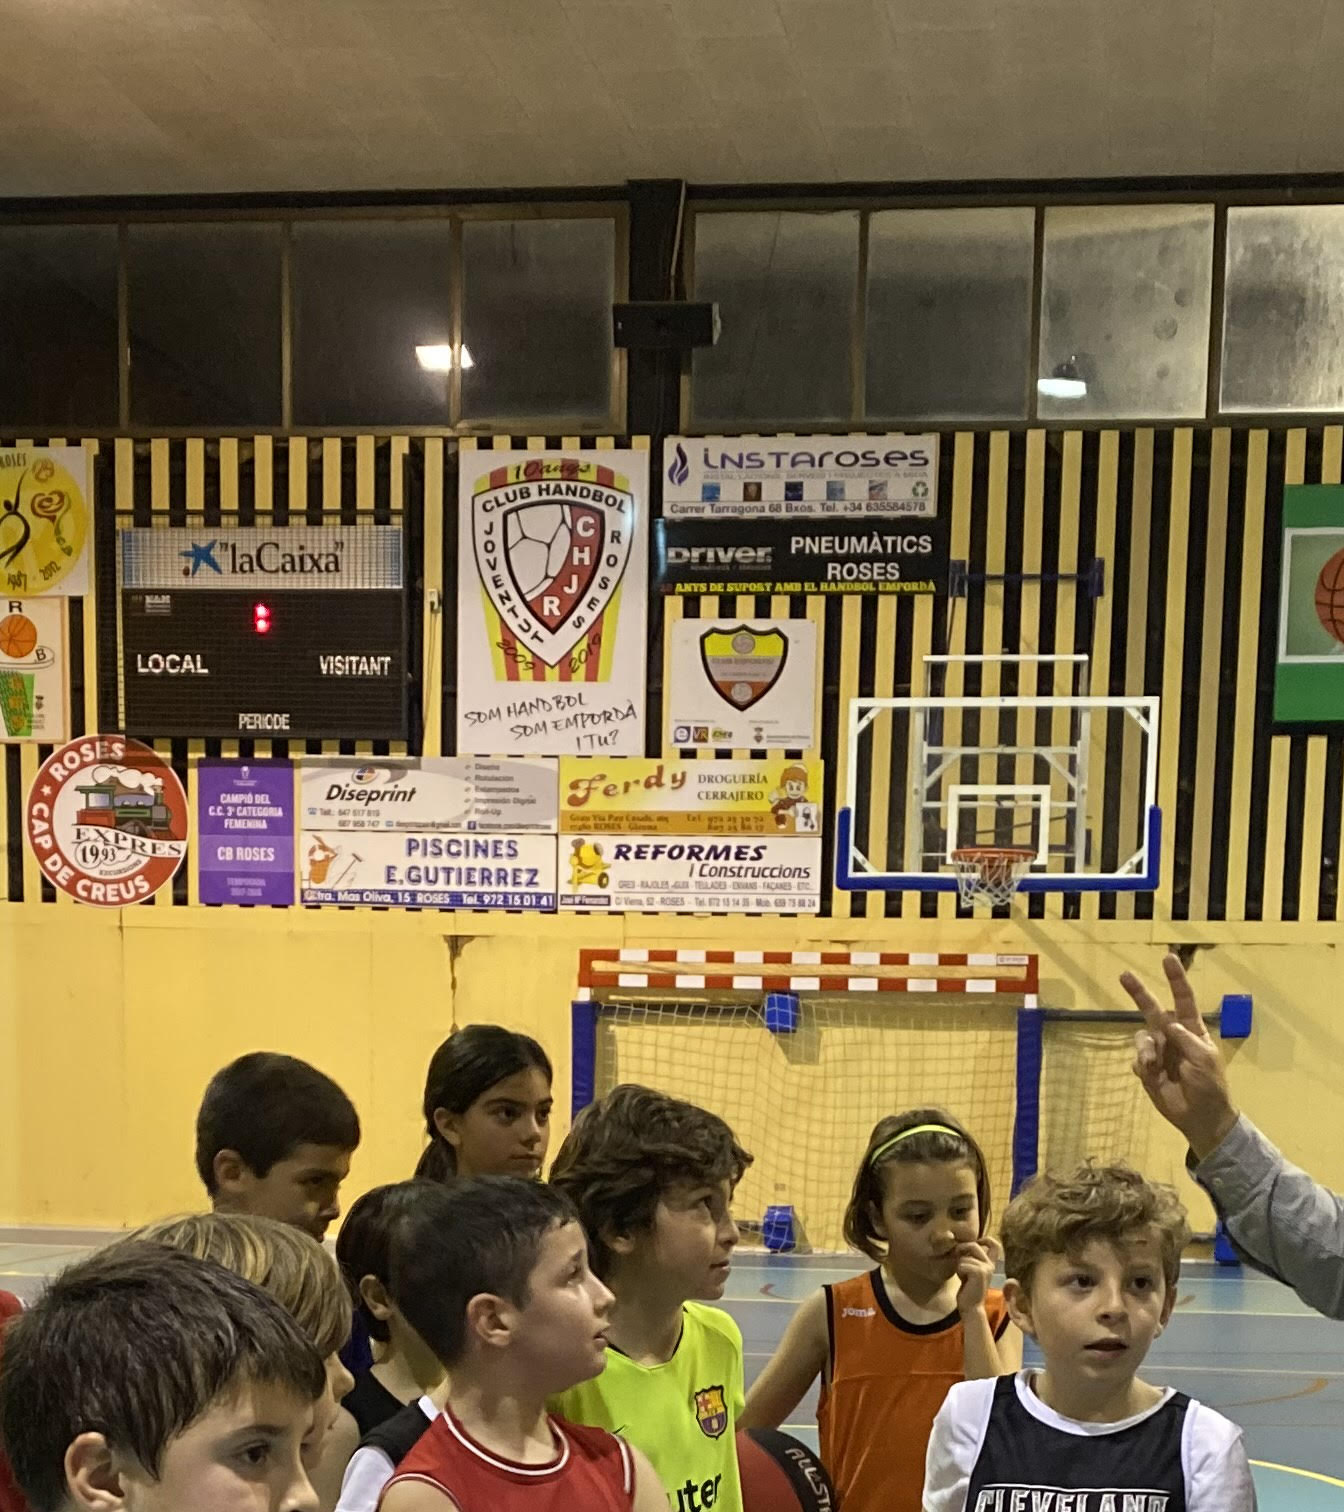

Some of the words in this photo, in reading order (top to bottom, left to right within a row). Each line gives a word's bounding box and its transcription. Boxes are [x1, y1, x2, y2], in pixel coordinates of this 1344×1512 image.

[482, 486, 531, 513] CLUB
[538, 484, 626, 513] HANDBOL
[670, 504, 705, 514] Carrer
[710, 503, 765, 515] Tarragona
[768, 503, 782, 513] 68
[820, 503, 838, 512] Tel.
[843, 502, 862, 512] +34
[790, 531, 932, 554] PNEUMÀTICS
[827, 562, 900, 580] ROSES
[675, 582, 707, 593] ANYS
[709, 582, 724, 592] DE
[774, 582, 802, 592] AMB
[804, 582, 817, 592] EL
[8, 601, 23, 613] R
[137, 654, 209, 674] LOCAL
[319, 655, 391, 675] VISITANT
[238, 713, 291, 730] PERIODE
[48, 741, 126, 782] ROSES
[566, 764, 687, 807] Ferdy
[698, 773, 768, 784] DROGUERÍA
[254, 794, 271, 805] DEL
[325, 783, 417, 806] Diseprint
[697, 790, 764, 802] CERRAJERO
[236, 806, 283, 817] CATEGORIA
[75, 827, 182, 856] EXPRES
[405, 837, 519, 859] PISCINES
[31, 802, 53, 850] CAP
[44, 852, 75, 887] DE
[76, 874, 150, 903] CREUS
[81, 844, 116, 864] 1993
[217, 846, 233, 861] CB
[236, 847, 275, 861] ROSES
[614, 843, 767, 861] REFORMES
[385, 864, 540, 888] E.GUTIERREZ
[698, 863, 811, 878] Construccions
[337, 891, 360, 902] Mas
[397, 892, 410, 903] 15
[417, 892, 450, 904] ROSES
[483, 894, 504, 905] 972
[523, 894, 536, 906] 01
[540, 895, 553, 906] 41
[660, 897, 685, 906] ROSES
